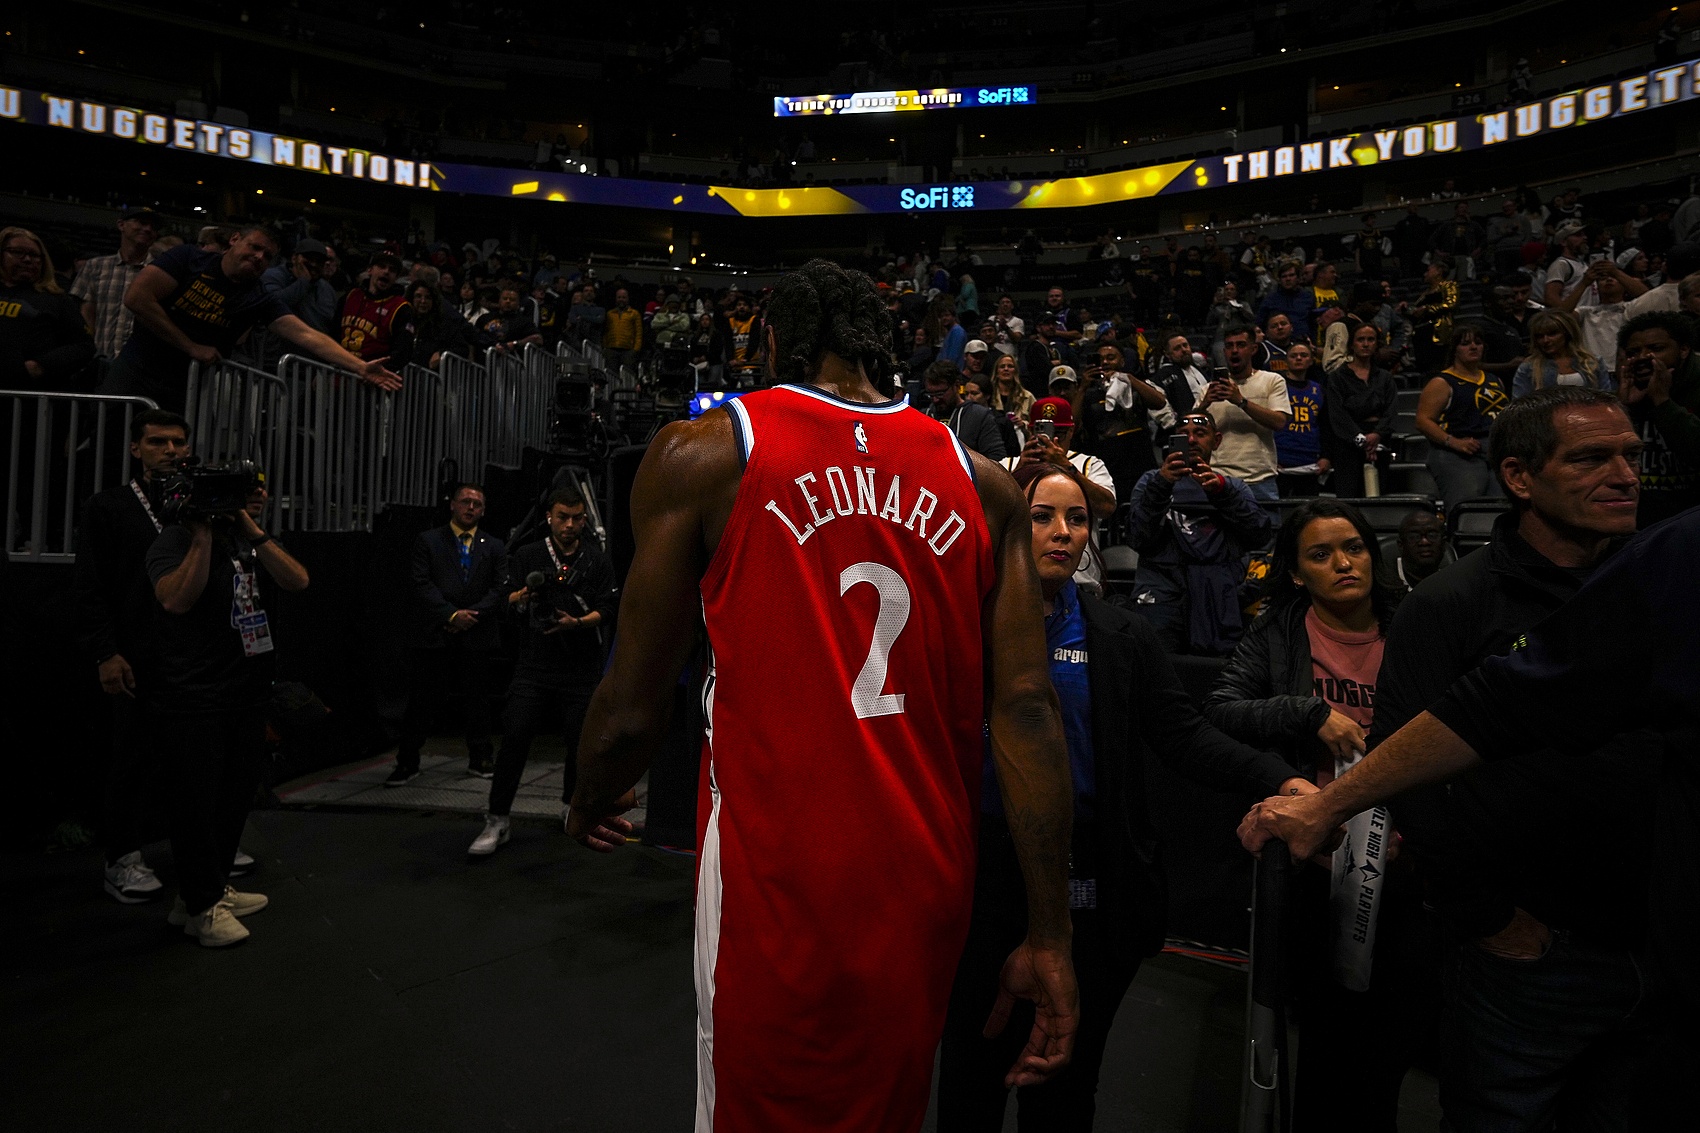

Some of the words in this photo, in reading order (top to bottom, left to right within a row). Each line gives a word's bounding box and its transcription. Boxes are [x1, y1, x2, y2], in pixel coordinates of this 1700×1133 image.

[978, 88, 1012, 104] SoFi
[46, 96, 252, 159] NUGGETS
[273, 135, 431, 188] NATION!
[1223, 136, 1354, 184] THANK
[1373, 120, 1459, 161] YOU
[900, 187, 949, 210] SoFi
[183, 289, 225, 316] NUGGETS
[191, 279, 225, 306] DENVER
[1288, 422, 1311, 433] CITY
[1293, 406, 1309, 422] 15
[765, 466, 966, 556] LEONARD
[840, 562, 910, 719] 2
[1366, 831, 1382, 860] HIGH
[1353, 885, 1374, 944] PLAYOFFS
